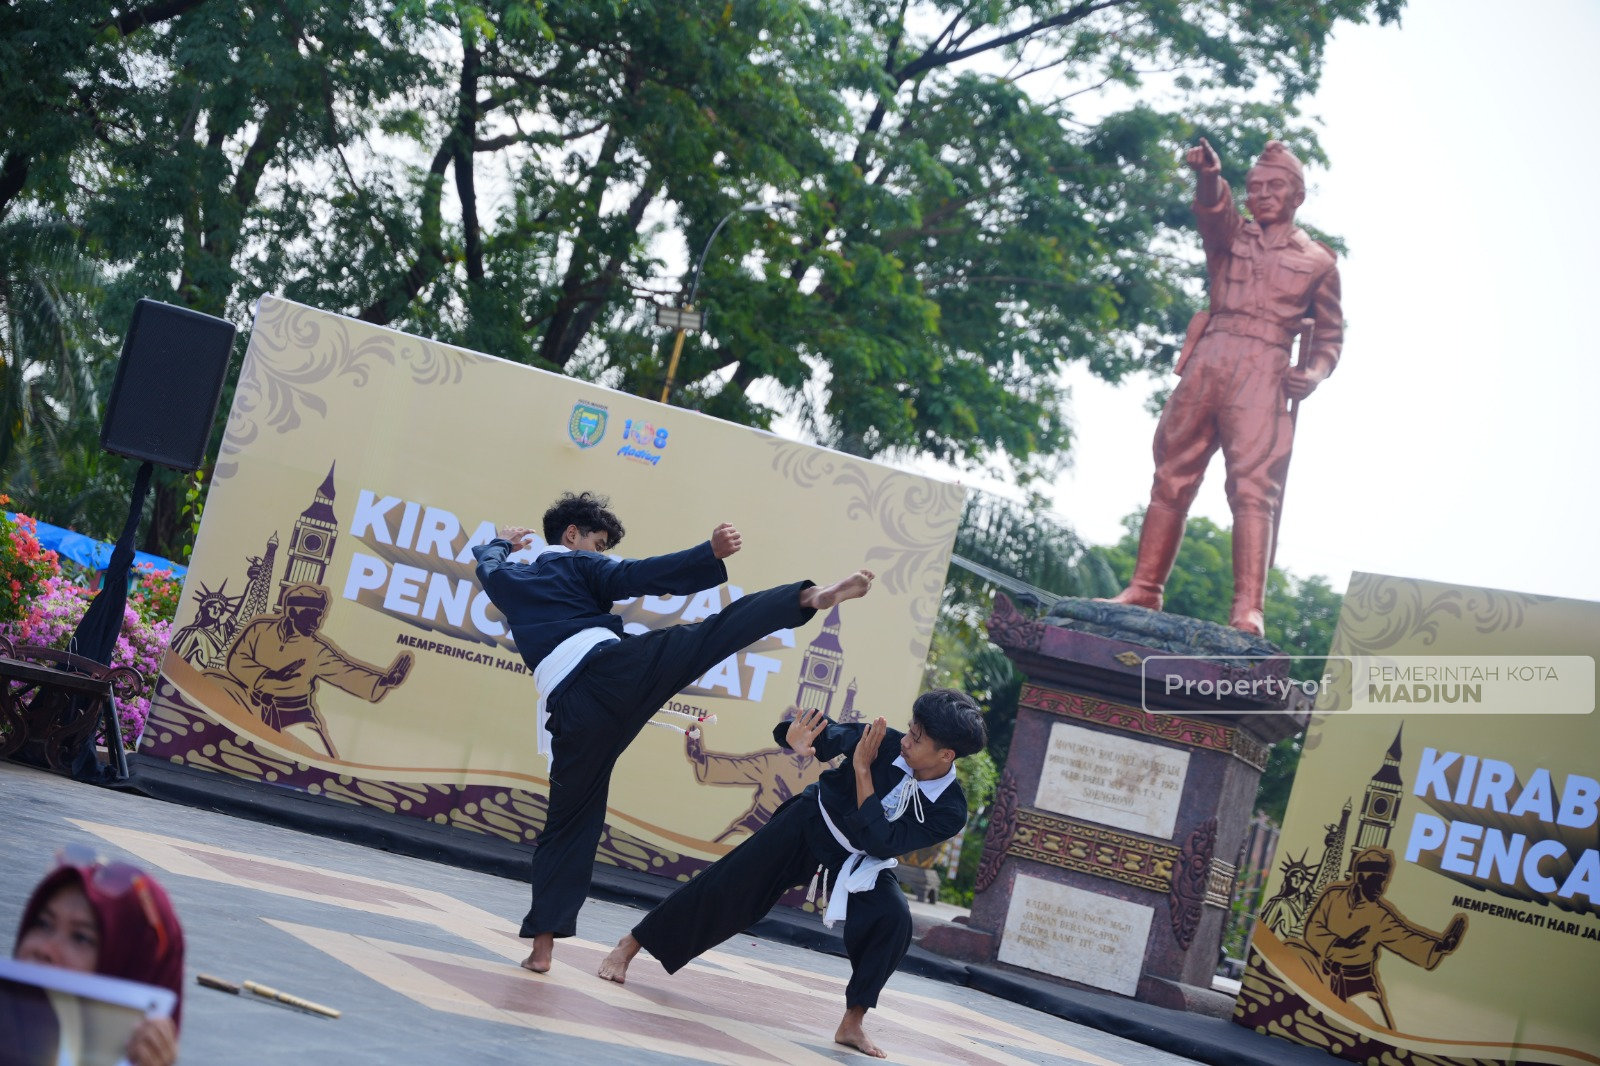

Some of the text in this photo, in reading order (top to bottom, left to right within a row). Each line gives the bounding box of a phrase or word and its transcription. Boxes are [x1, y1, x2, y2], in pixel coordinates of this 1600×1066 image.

[396, 633, 527, 675] MEMPERINGATI HARI
[668, 701, 708, 718] 108TH
[1413, 747, 1600, 829] KIRAB
[1452, 895, 1545, 927] MEMPERINGATI
[1547, 918, 1580, 935] HARI
